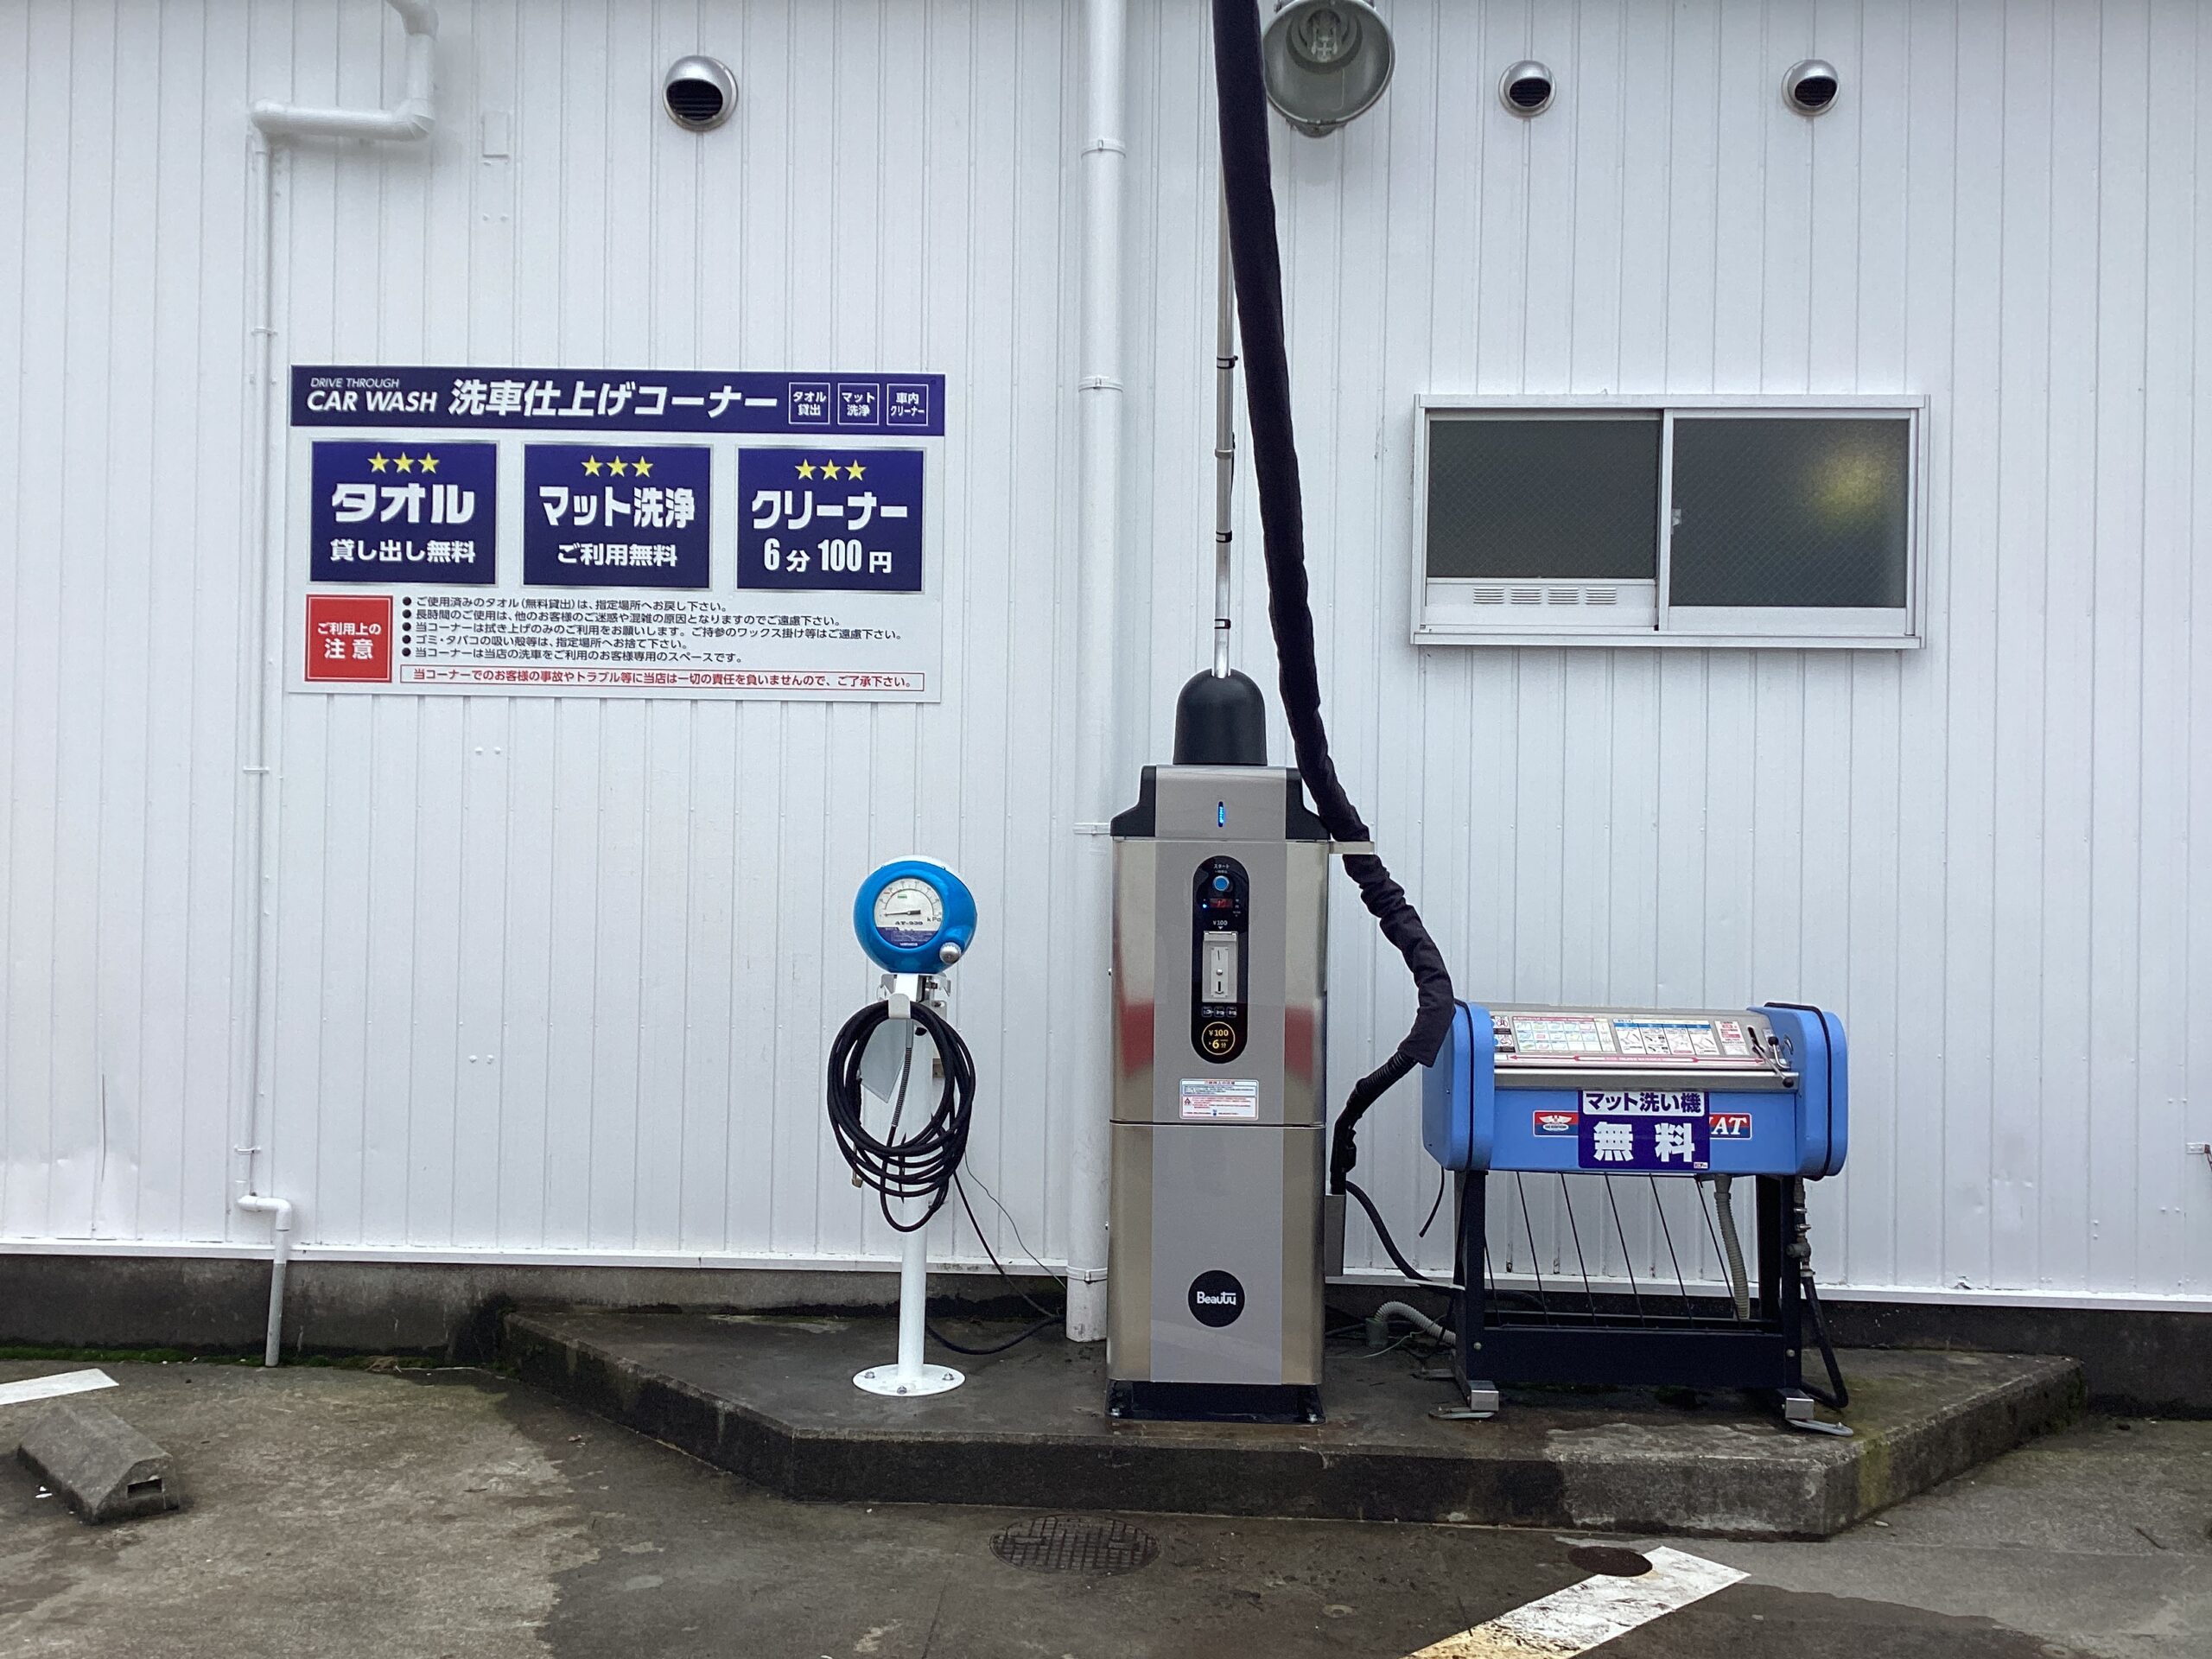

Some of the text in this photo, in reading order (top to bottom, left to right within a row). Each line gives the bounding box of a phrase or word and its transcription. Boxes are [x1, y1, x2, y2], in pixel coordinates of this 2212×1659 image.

[310, 378, 399, 388] DRIVE THROUGH
[307, 391, 437, 412] CAR WASH
[448, 378, 778, 417] 洗車仕上げコーナー
[792, 391, 827, 403] タオル
[842, 391, 875, 404] マット
[895, 392, 919, 404] 車内
[798, 404, 821, 416] 貸出
[847, 404, 871, 416] 洗浄
[890, 405, 925, 416] クリーナー
[331, 482, 475, 524] タオル
[538, 486, 696, 529] マット洗浄
[751, 490, 908, 531] クリーナー
[329, 538, 476, 563] 貸し出し無料
[557, 542, 678, 567] ご利用無料
[317, 622, 382, 636] ご利用上の
[324, 638, 375, 660] 注意
[1586, 1092, 1702, 1114] マット洗い機
[1592, 1121, 1696, 1163] 無料
[1197, 1291, 1236, 1306] Beauty
